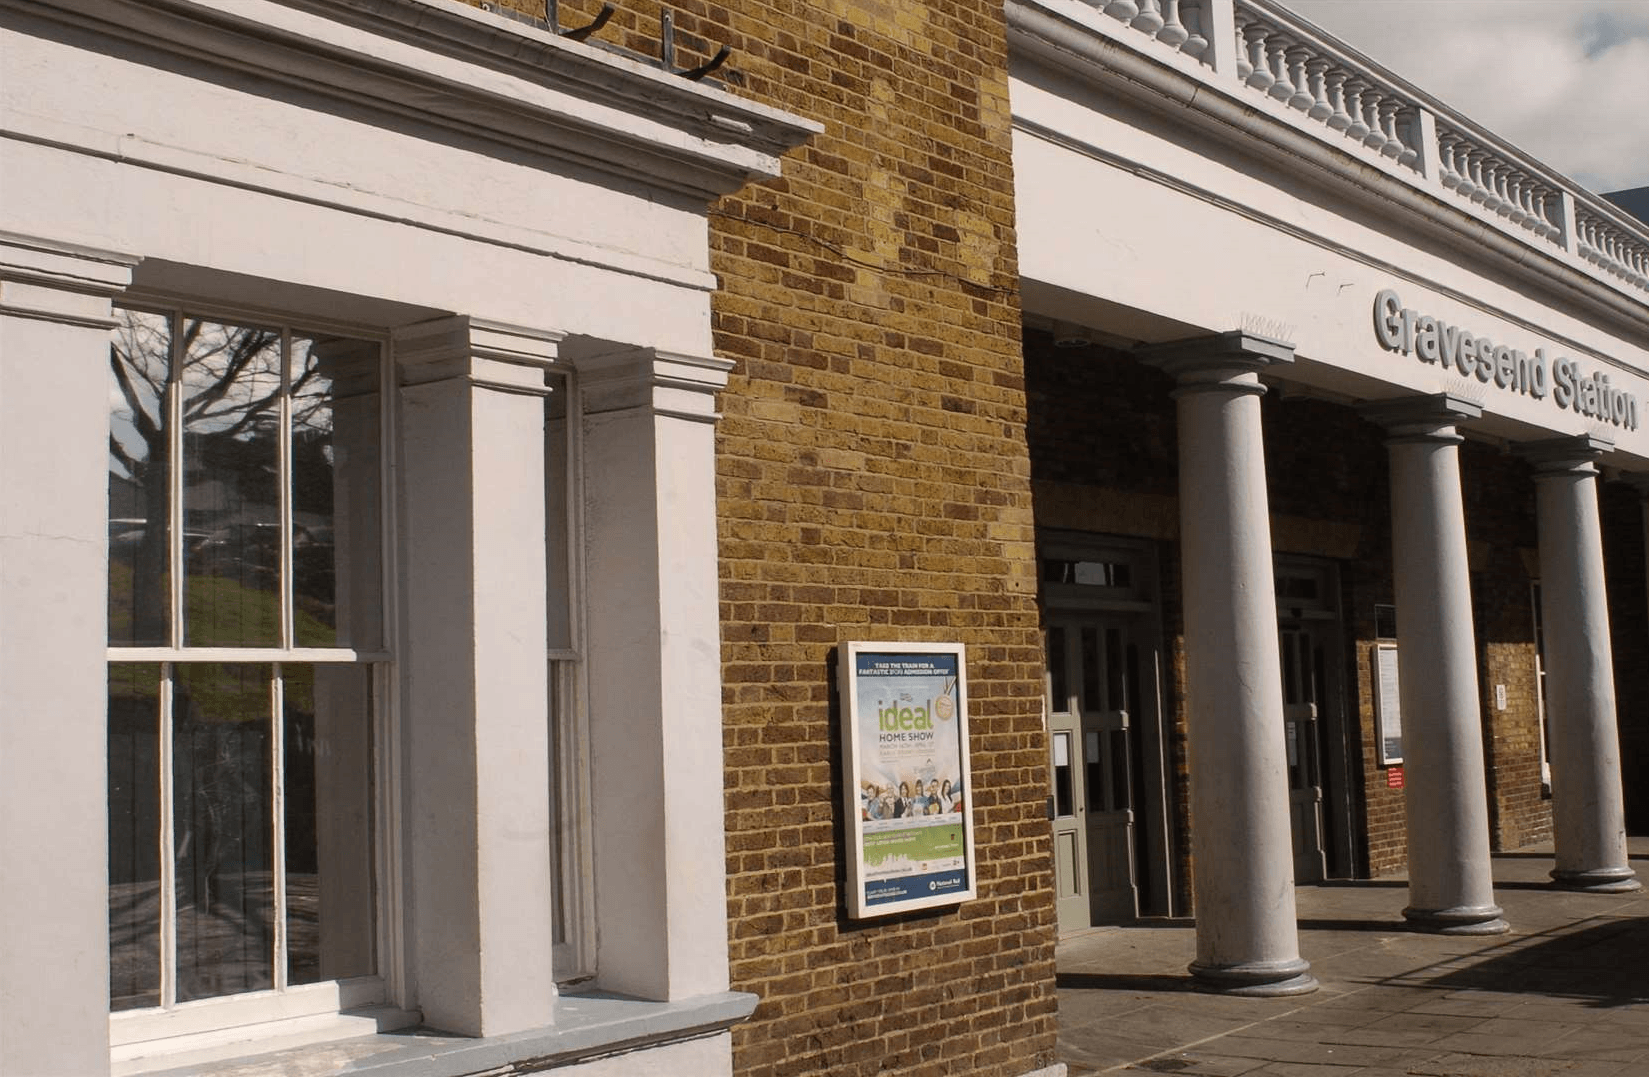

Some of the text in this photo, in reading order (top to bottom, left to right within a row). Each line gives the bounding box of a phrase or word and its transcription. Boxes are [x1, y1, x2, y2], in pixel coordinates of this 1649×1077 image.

[1373, 289, 1639, 432] Gravesend Station
[878, 699, 934, 731] ideal
[879, 732, 934, 742] HOME SHOW
